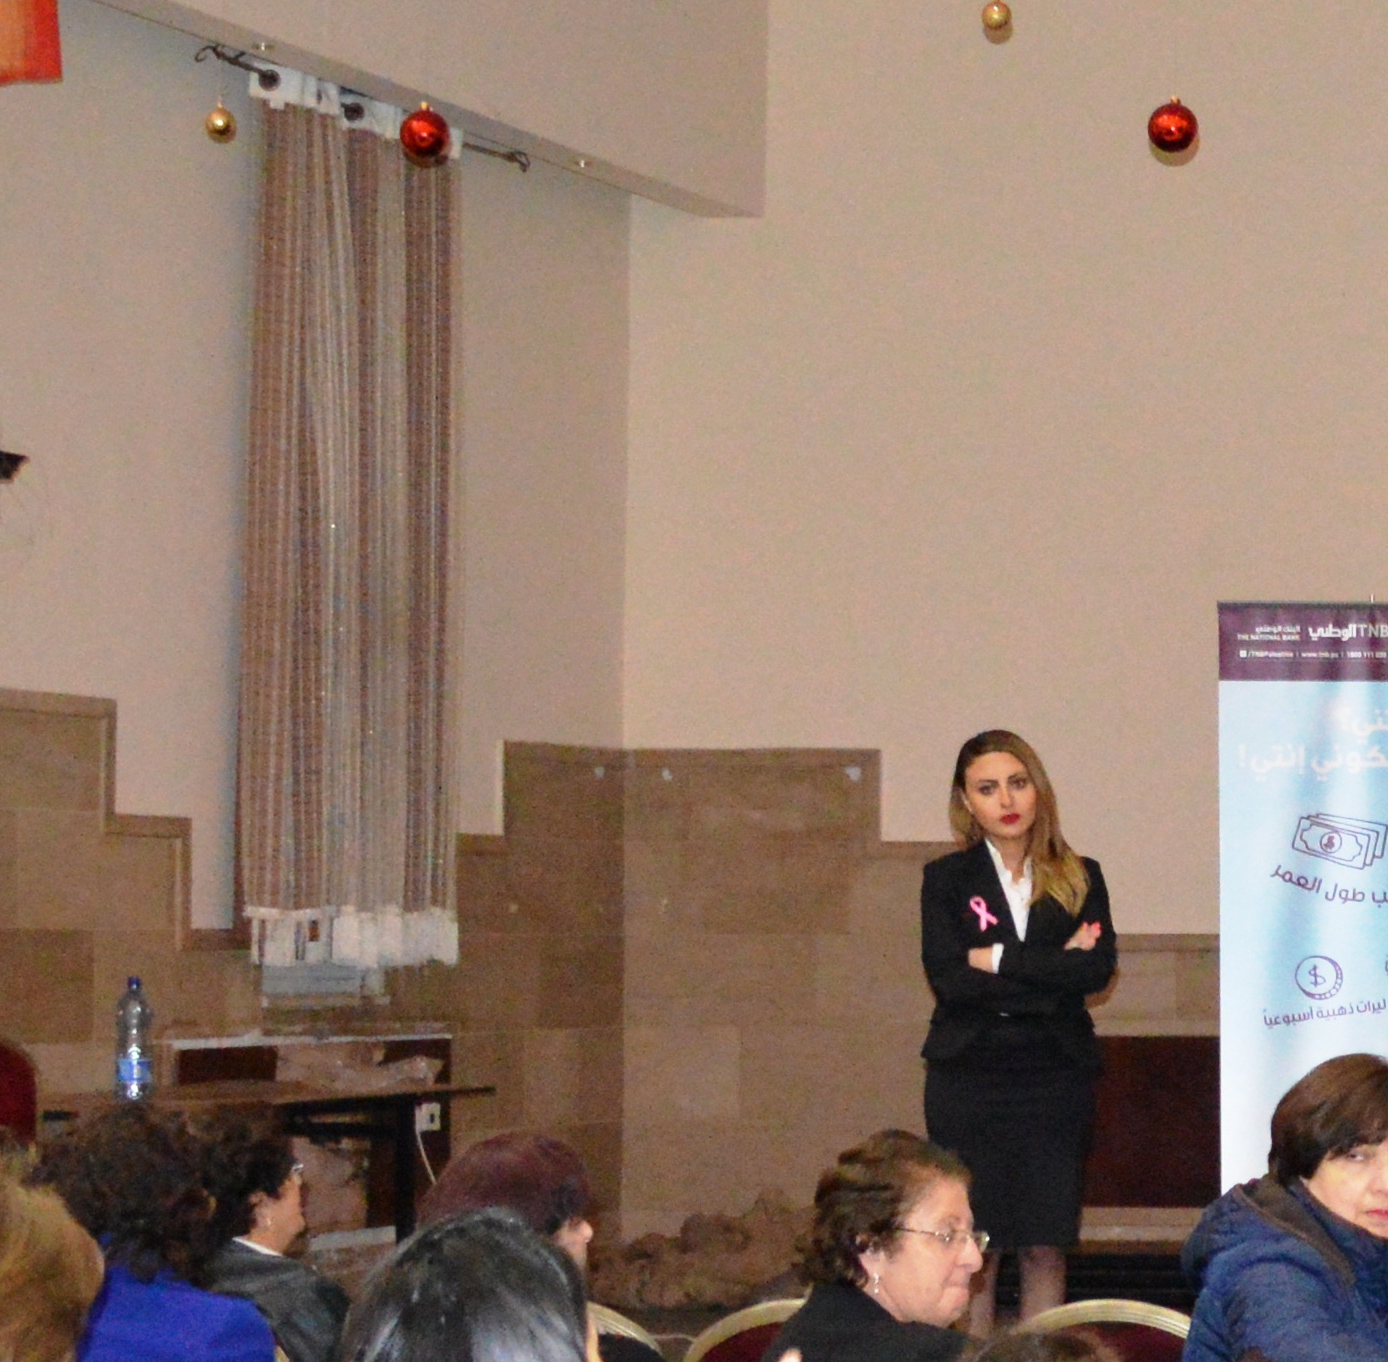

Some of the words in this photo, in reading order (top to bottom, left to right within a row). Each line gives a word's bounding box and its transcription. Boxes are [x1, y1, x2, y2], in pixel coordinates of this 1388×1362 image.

[1308, 623, 1357, 641] الوطني
[1270, 864, 1322, 894] العمر
[1324, 883, 1365, 904] طول
[1316, 1003, 1354, 1020] ذهبية
[1356, 999, 1387, 1014] ليرات
